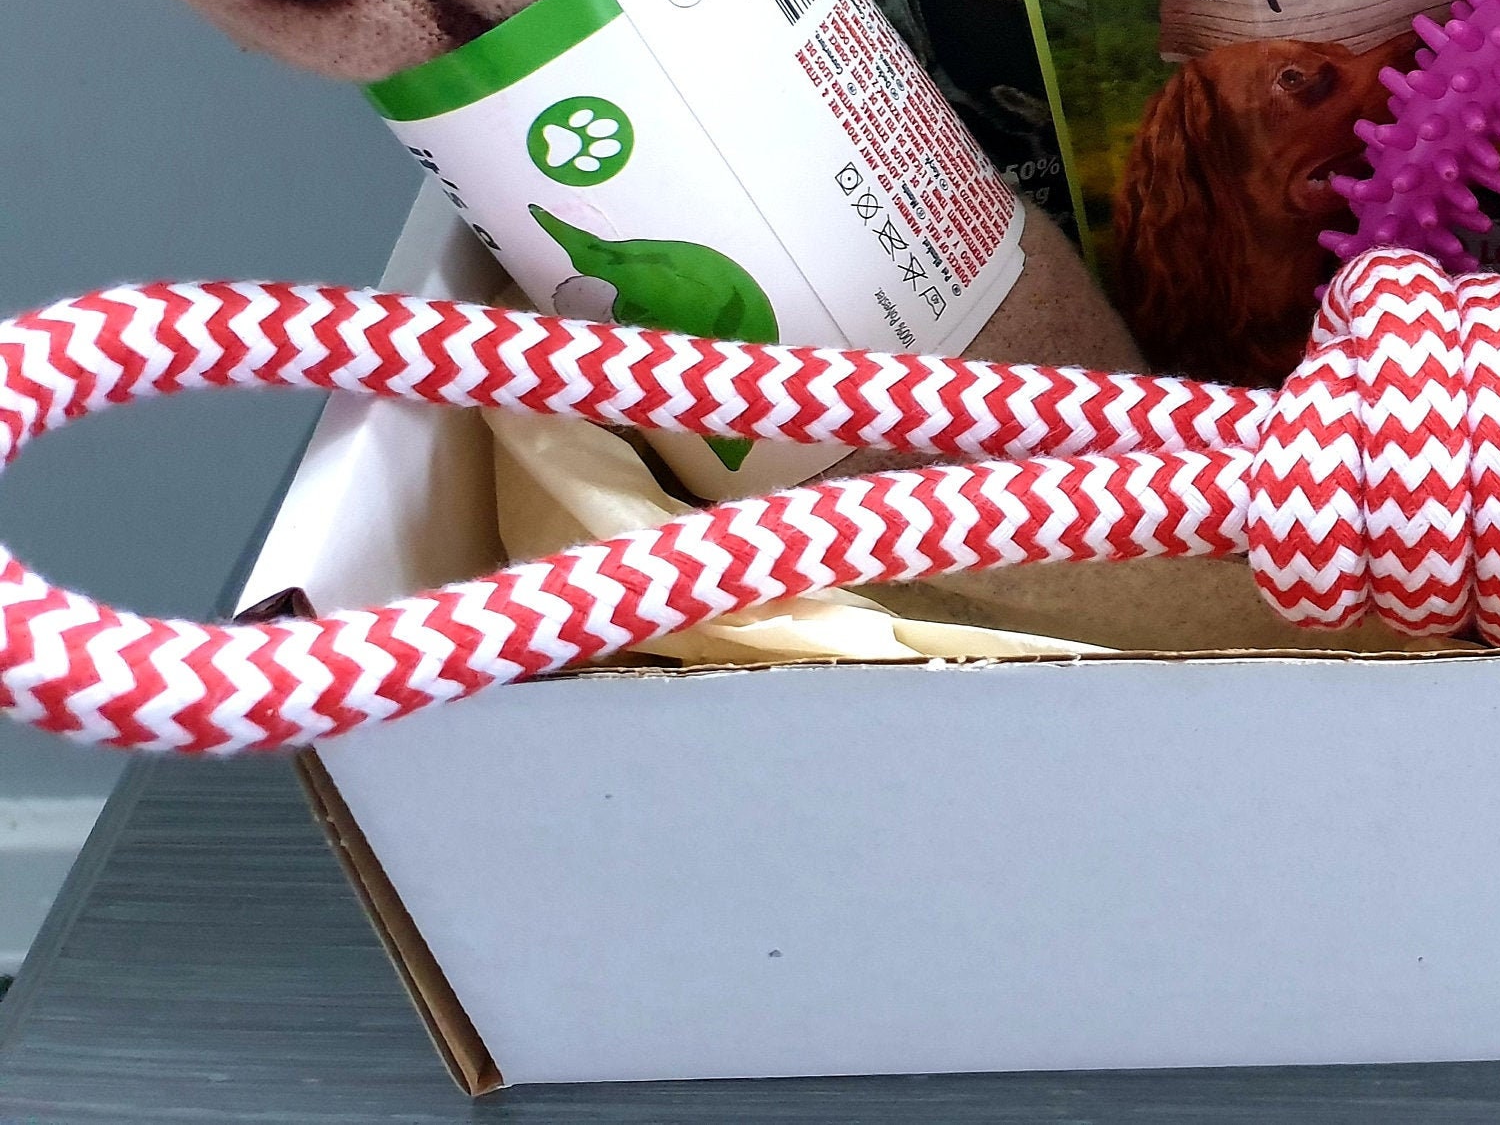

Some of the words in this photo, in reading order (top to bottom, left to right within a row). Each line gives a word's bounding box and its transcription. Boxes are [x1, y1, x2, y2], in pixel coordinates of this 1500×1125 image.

[804, 38, 817, 57] DEL
[794, 48, 822, 87] EXTREME
[827, 97, 843, 118] FIRE
[841, 118, 861, 145] FROM
[859, 146, 879, 170] AWAY
[890, 145, 909, 172] CALOR
[877, 173, 893, 193] KEEP
[909, 174, 919, 188] DE
[942, 224, 953, 238] DE
[938, 241, 949, 254] OF
[946, 251, 971, 287] SOURCES
[960, 250, 979, 277] FUEGO
[874, 286, 901, 327] Polyester.
[895, 321, 916, 349] 100%
